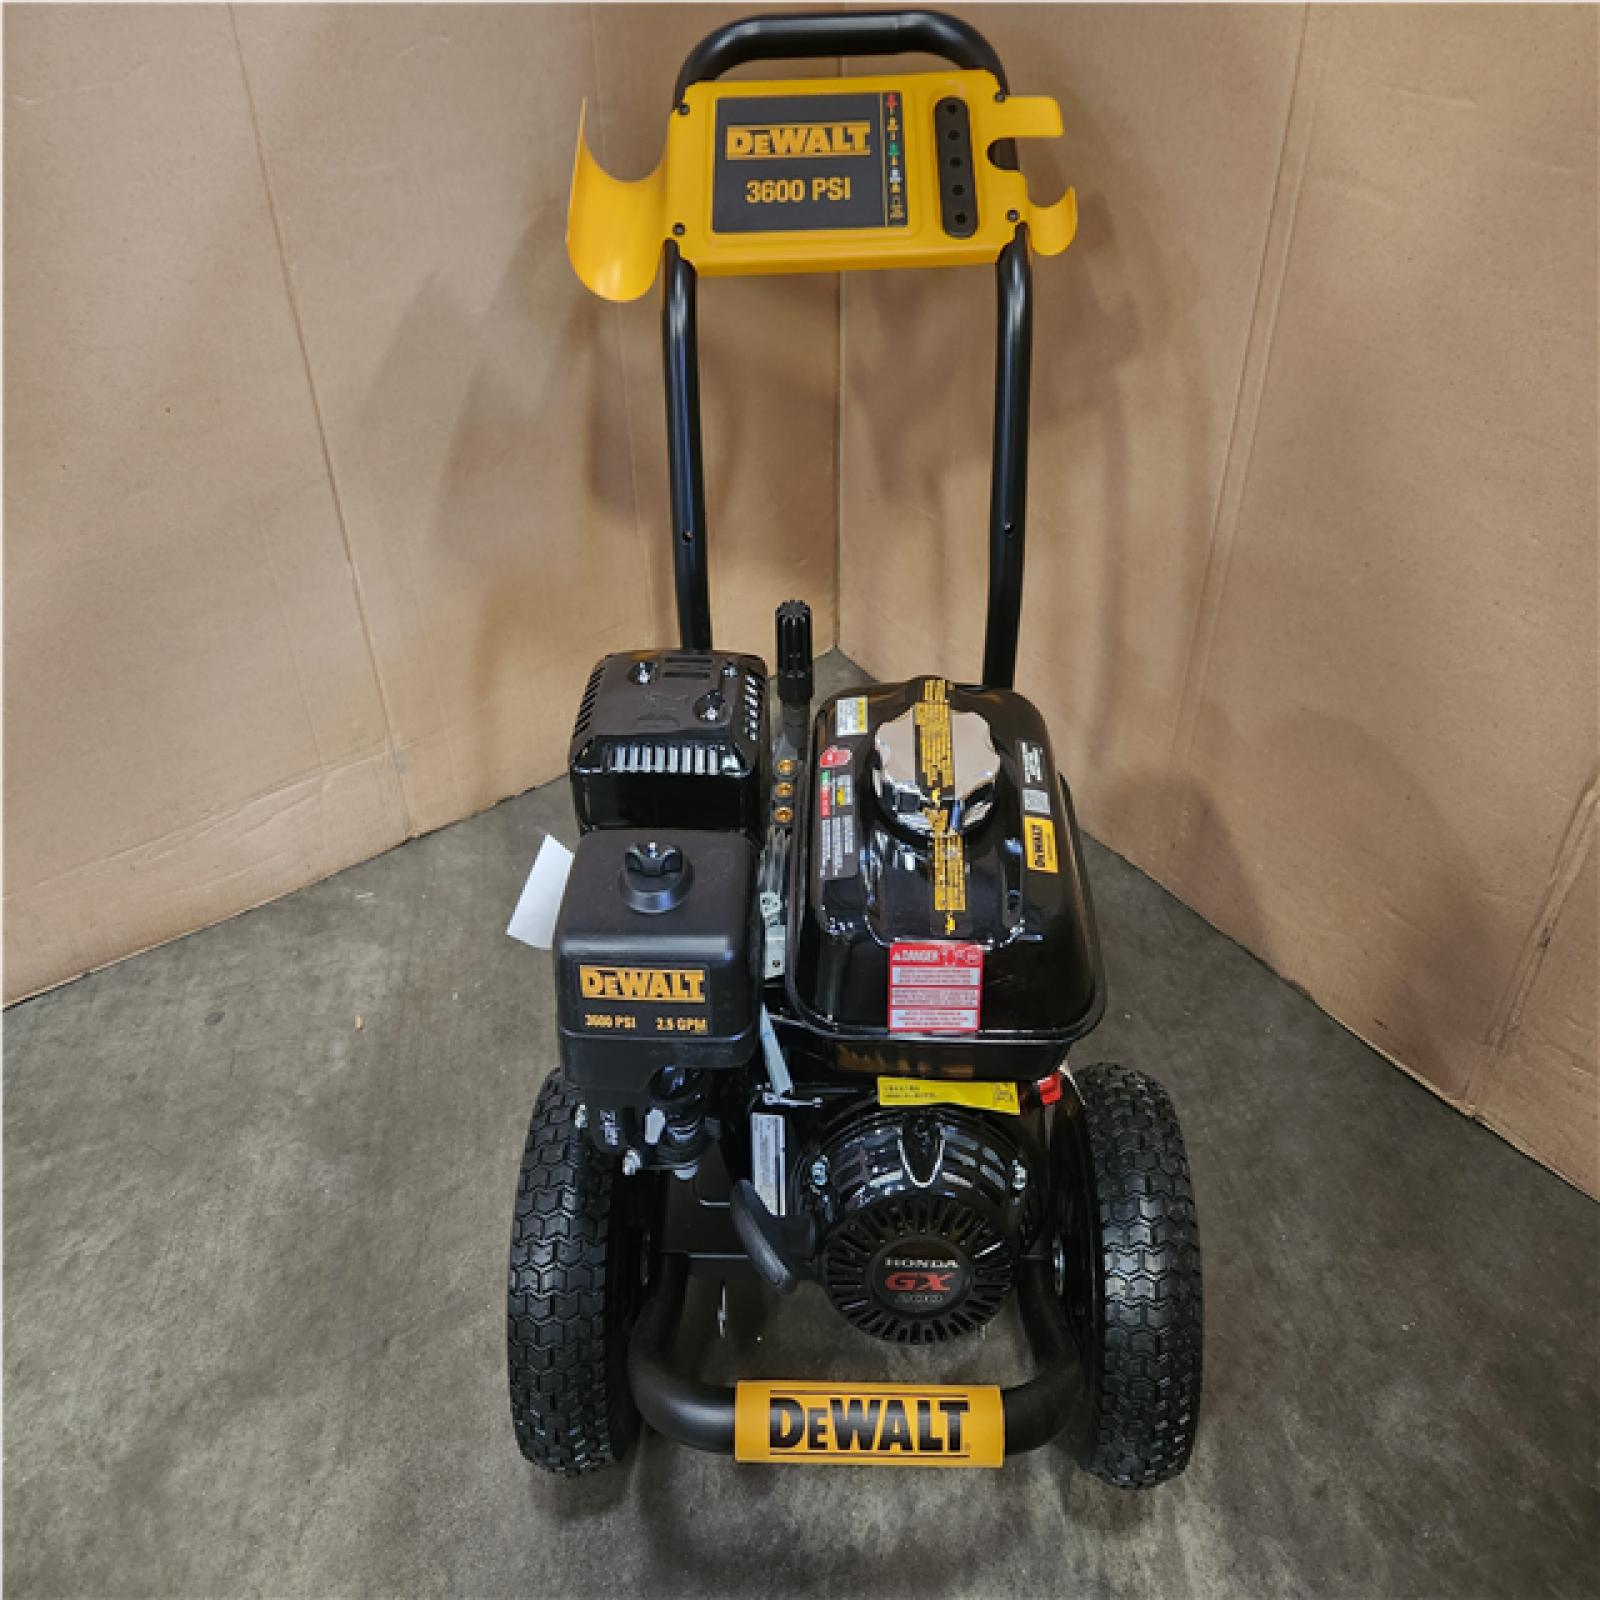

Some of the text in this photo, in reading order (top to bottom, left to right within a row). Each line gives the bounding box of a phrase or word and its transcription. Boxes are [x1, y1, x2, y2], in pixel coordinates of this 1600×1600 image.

[727, 121, 871, 159] DEWALT
[745, 176, 852, 203] 3600 PSI
[580, 966, 705, 1002] DEWALT
[884, 1257, 960, 1269] HONDA
[885, 1272, 957, 1291] GX
[770, 1398, 970, 1452] DEWALT
